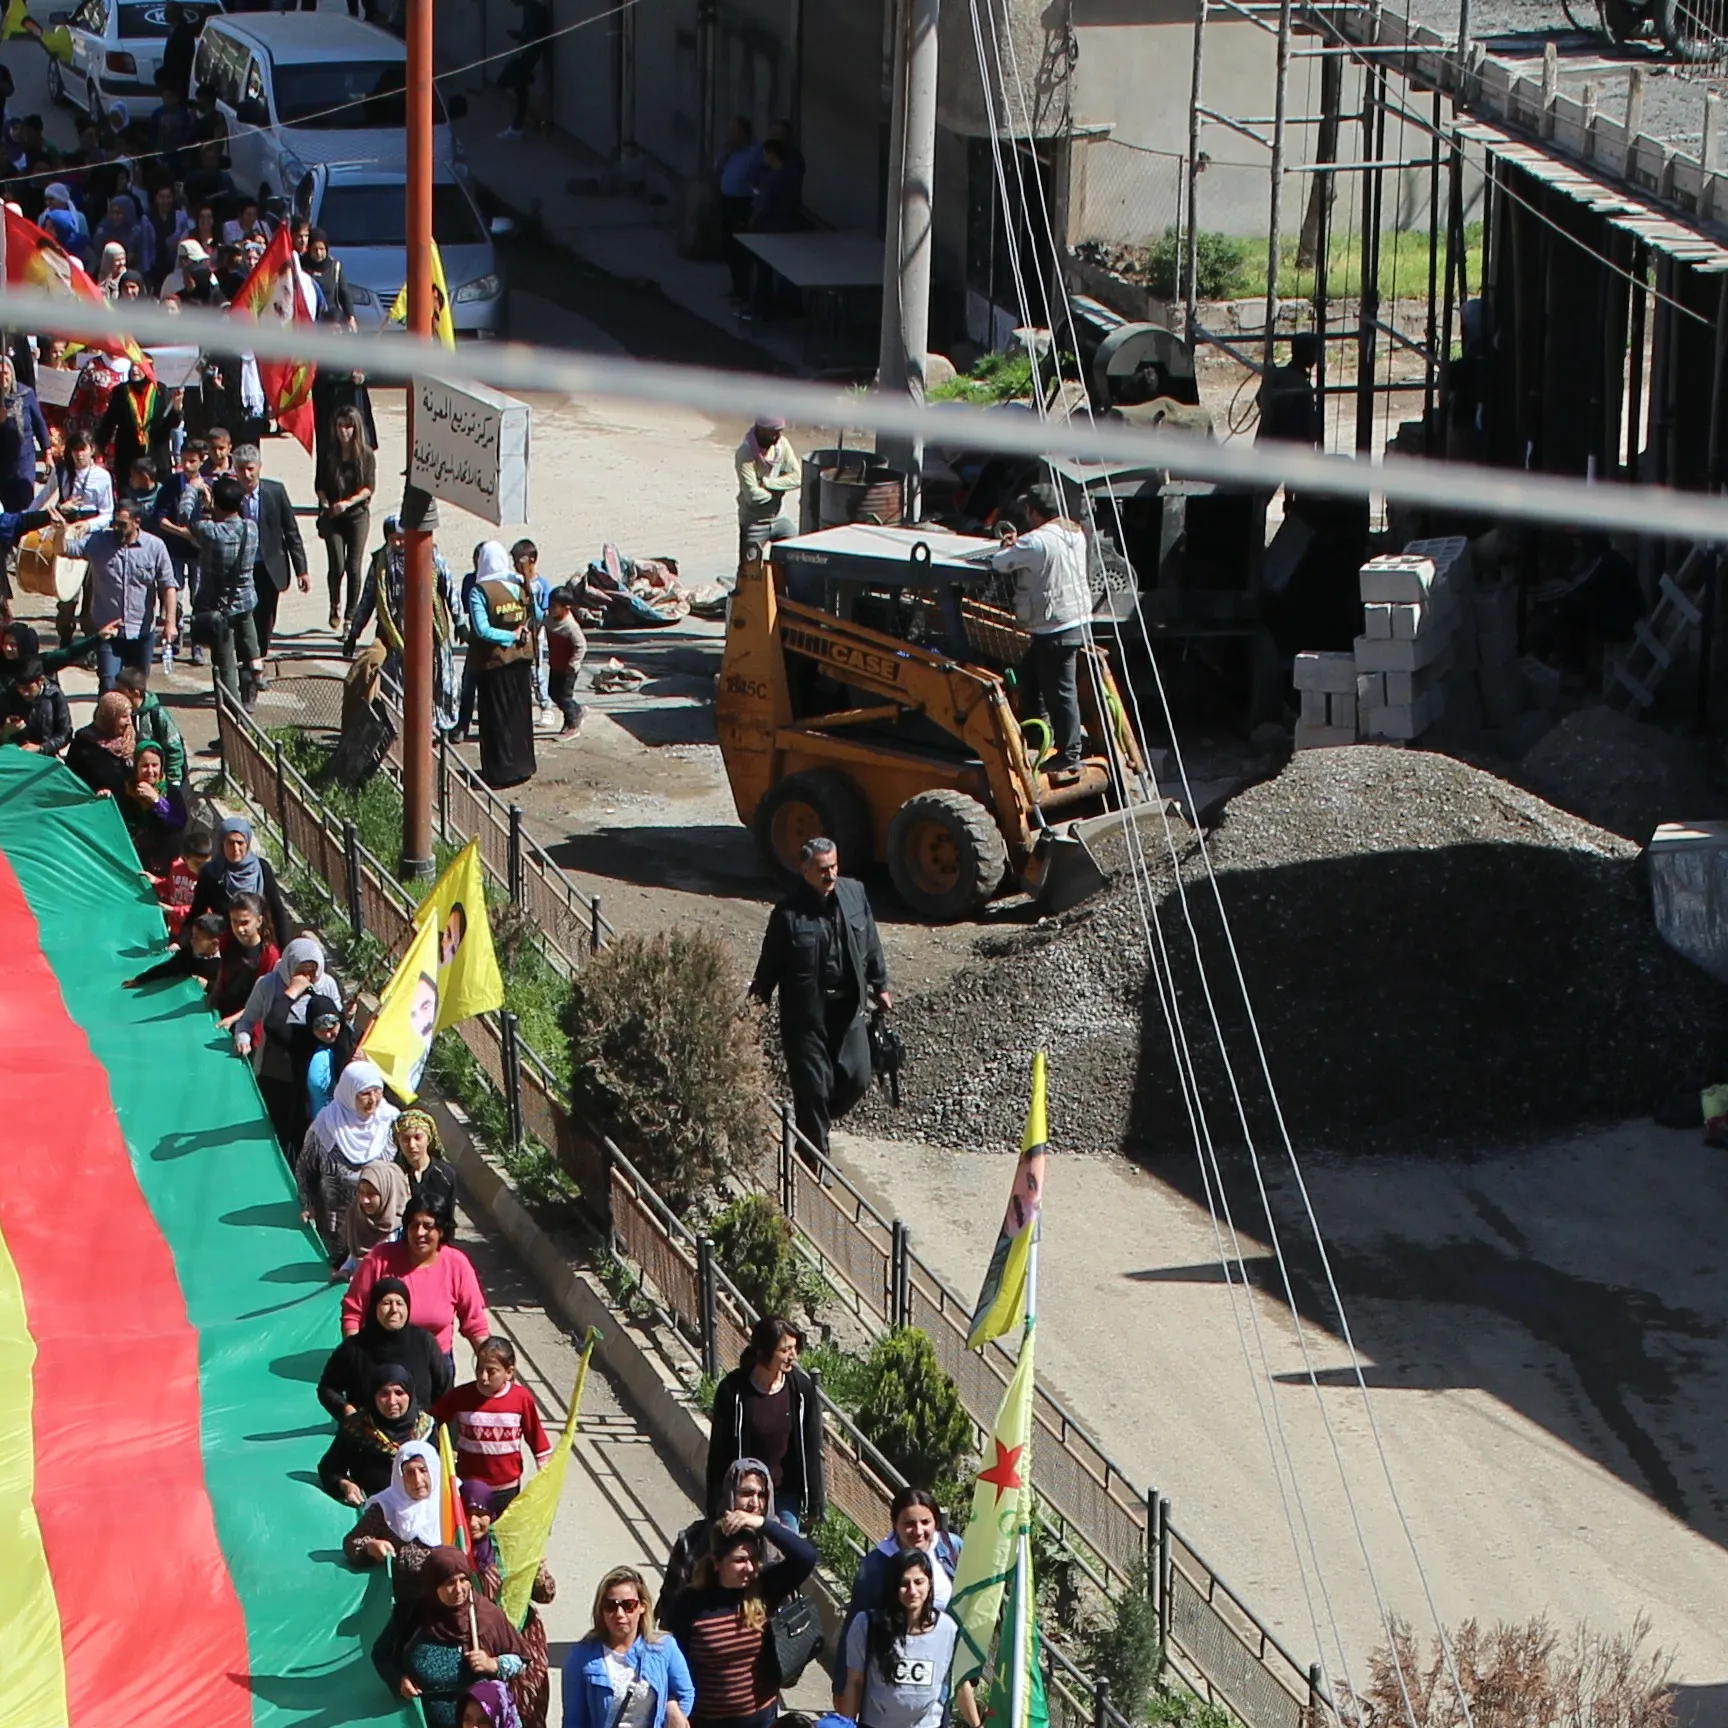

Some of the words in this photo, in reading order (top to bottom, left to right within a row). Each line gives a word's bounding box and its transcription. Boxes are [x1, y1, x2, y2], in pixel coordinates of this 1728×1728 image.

[422, 386, 452, 422] المعونة
[450, 411, 476, 437] توزيع
[830, 646, 895, 680] CASE
